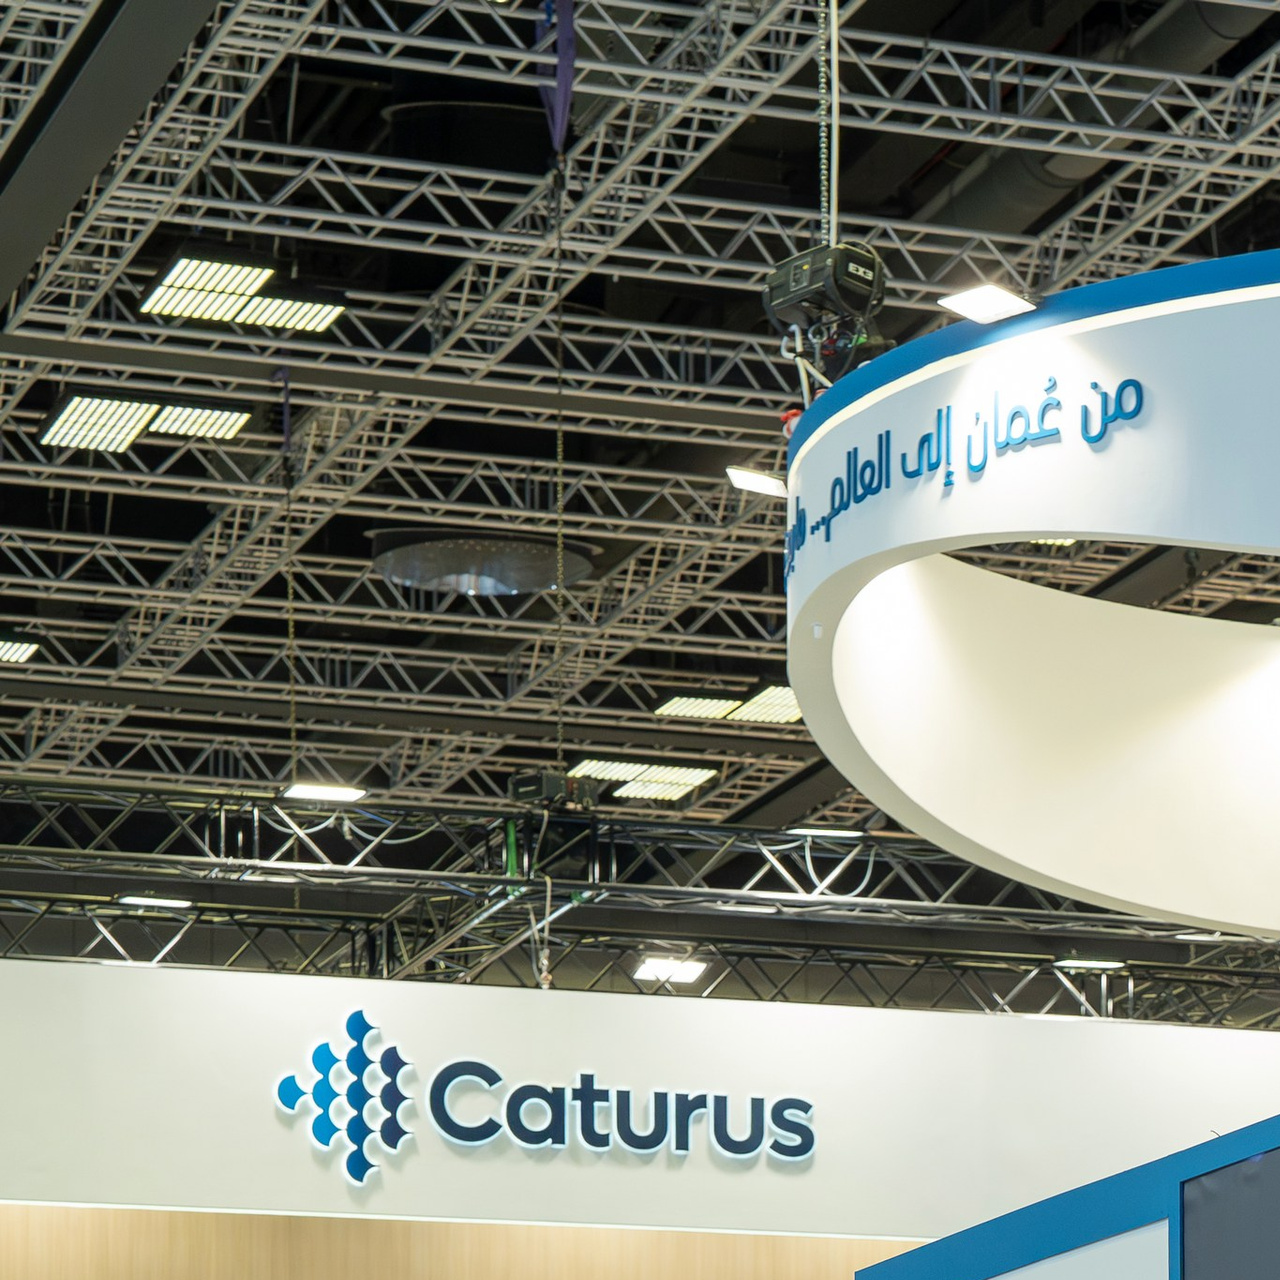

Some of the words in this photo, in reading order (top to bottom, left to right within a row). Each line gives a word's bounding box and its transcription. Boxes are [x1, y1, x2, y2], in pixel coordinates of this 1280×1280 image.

[900, 404, 952, 488] إلى
[1080, 378, 1144, 445] من
[429, 1060, 816, 1158] Caturus
